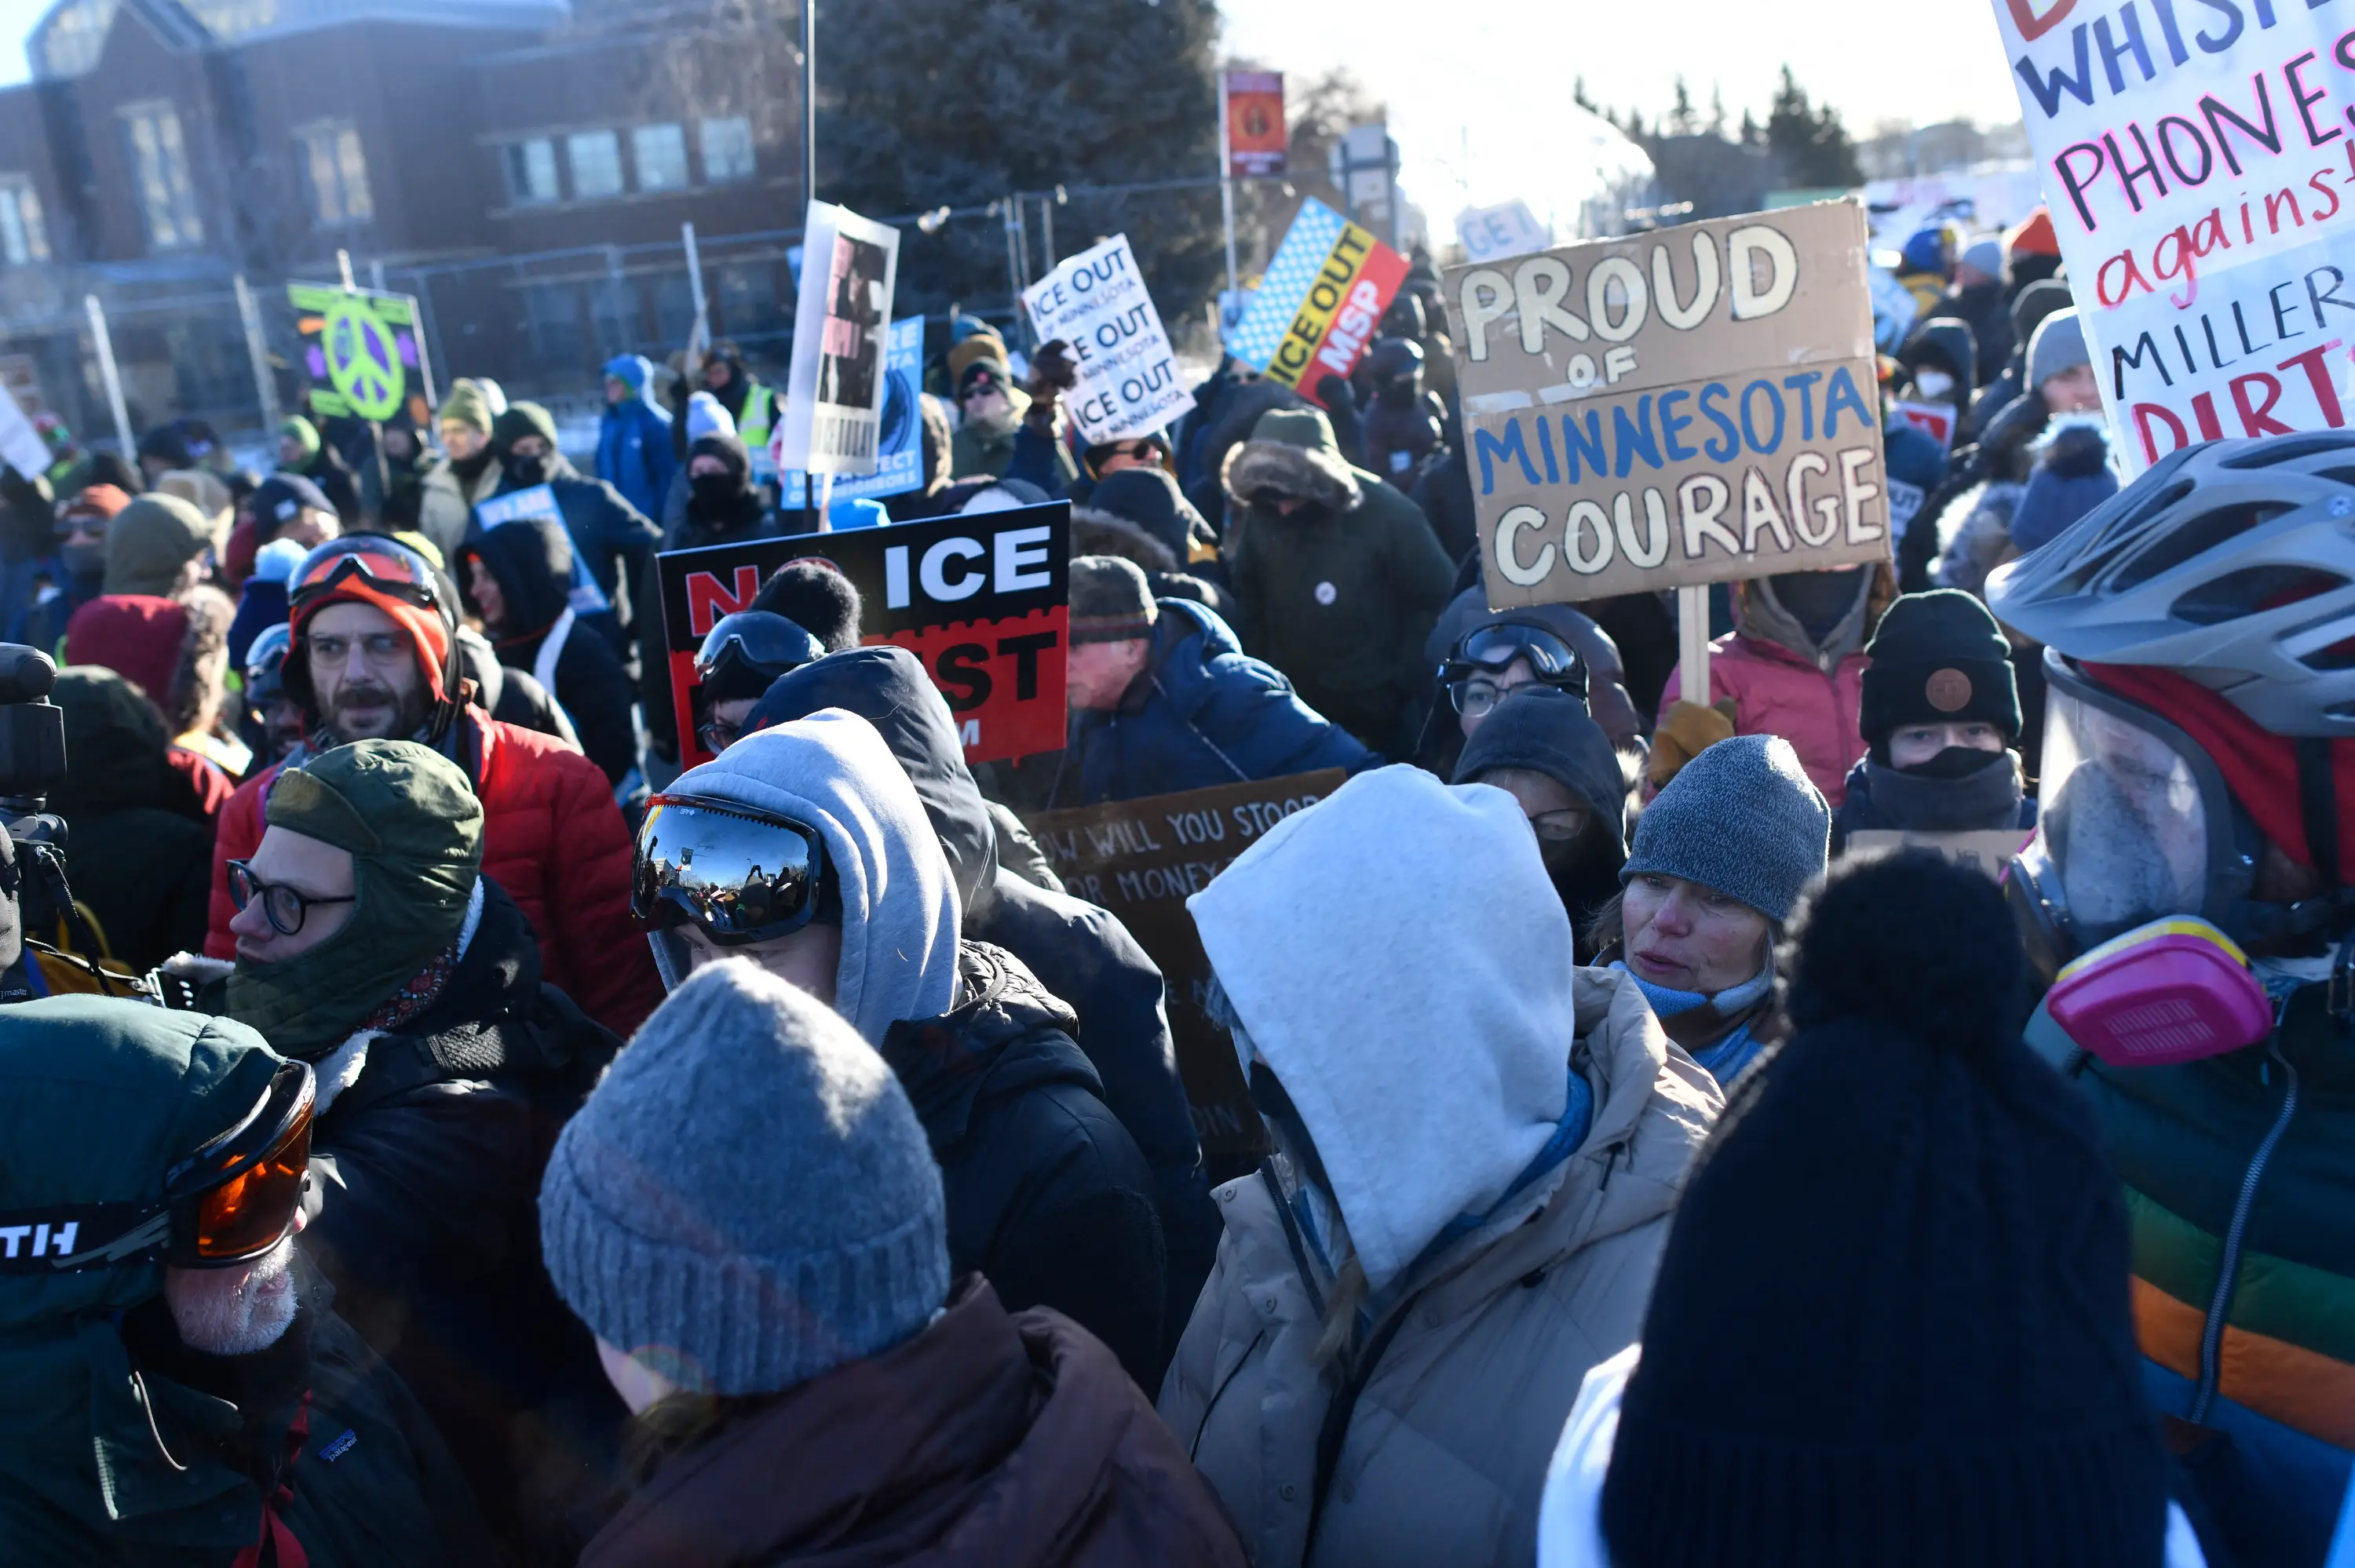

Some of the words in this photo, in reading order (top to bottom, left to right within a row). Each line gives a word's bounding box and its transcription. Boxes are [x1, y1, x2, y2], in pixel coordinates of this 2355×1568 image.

[1032, 282, 1069, 323] ICE
[1072, 247, 1125, 294] OUT
[1097, 301, 1150, 348] OUT
[1269, 316, 1323, 383] ICE
[1311, 227, 1366, 313] OUT
[1317, 279, 1381, 374] MSP
[1459, 224, 1798, 362] PROUD
[1075, 391, 1118, 429] ICE
[1122, 357, 1174, 404] OUT
[1567, 345, 1639, 388] OF
[2130, 338, 2355, 469] DIRT
[1474, 366, 1874, 495] MINNESOTA
[1493, 446, 1884, 587] COURAGE
[885, 525, 1052, 611] ICE
[1038, 829, 1078, 861] OW
[1084, 819, 1162, 858] WILL
[1166, 808, 1225, 845] YOU
